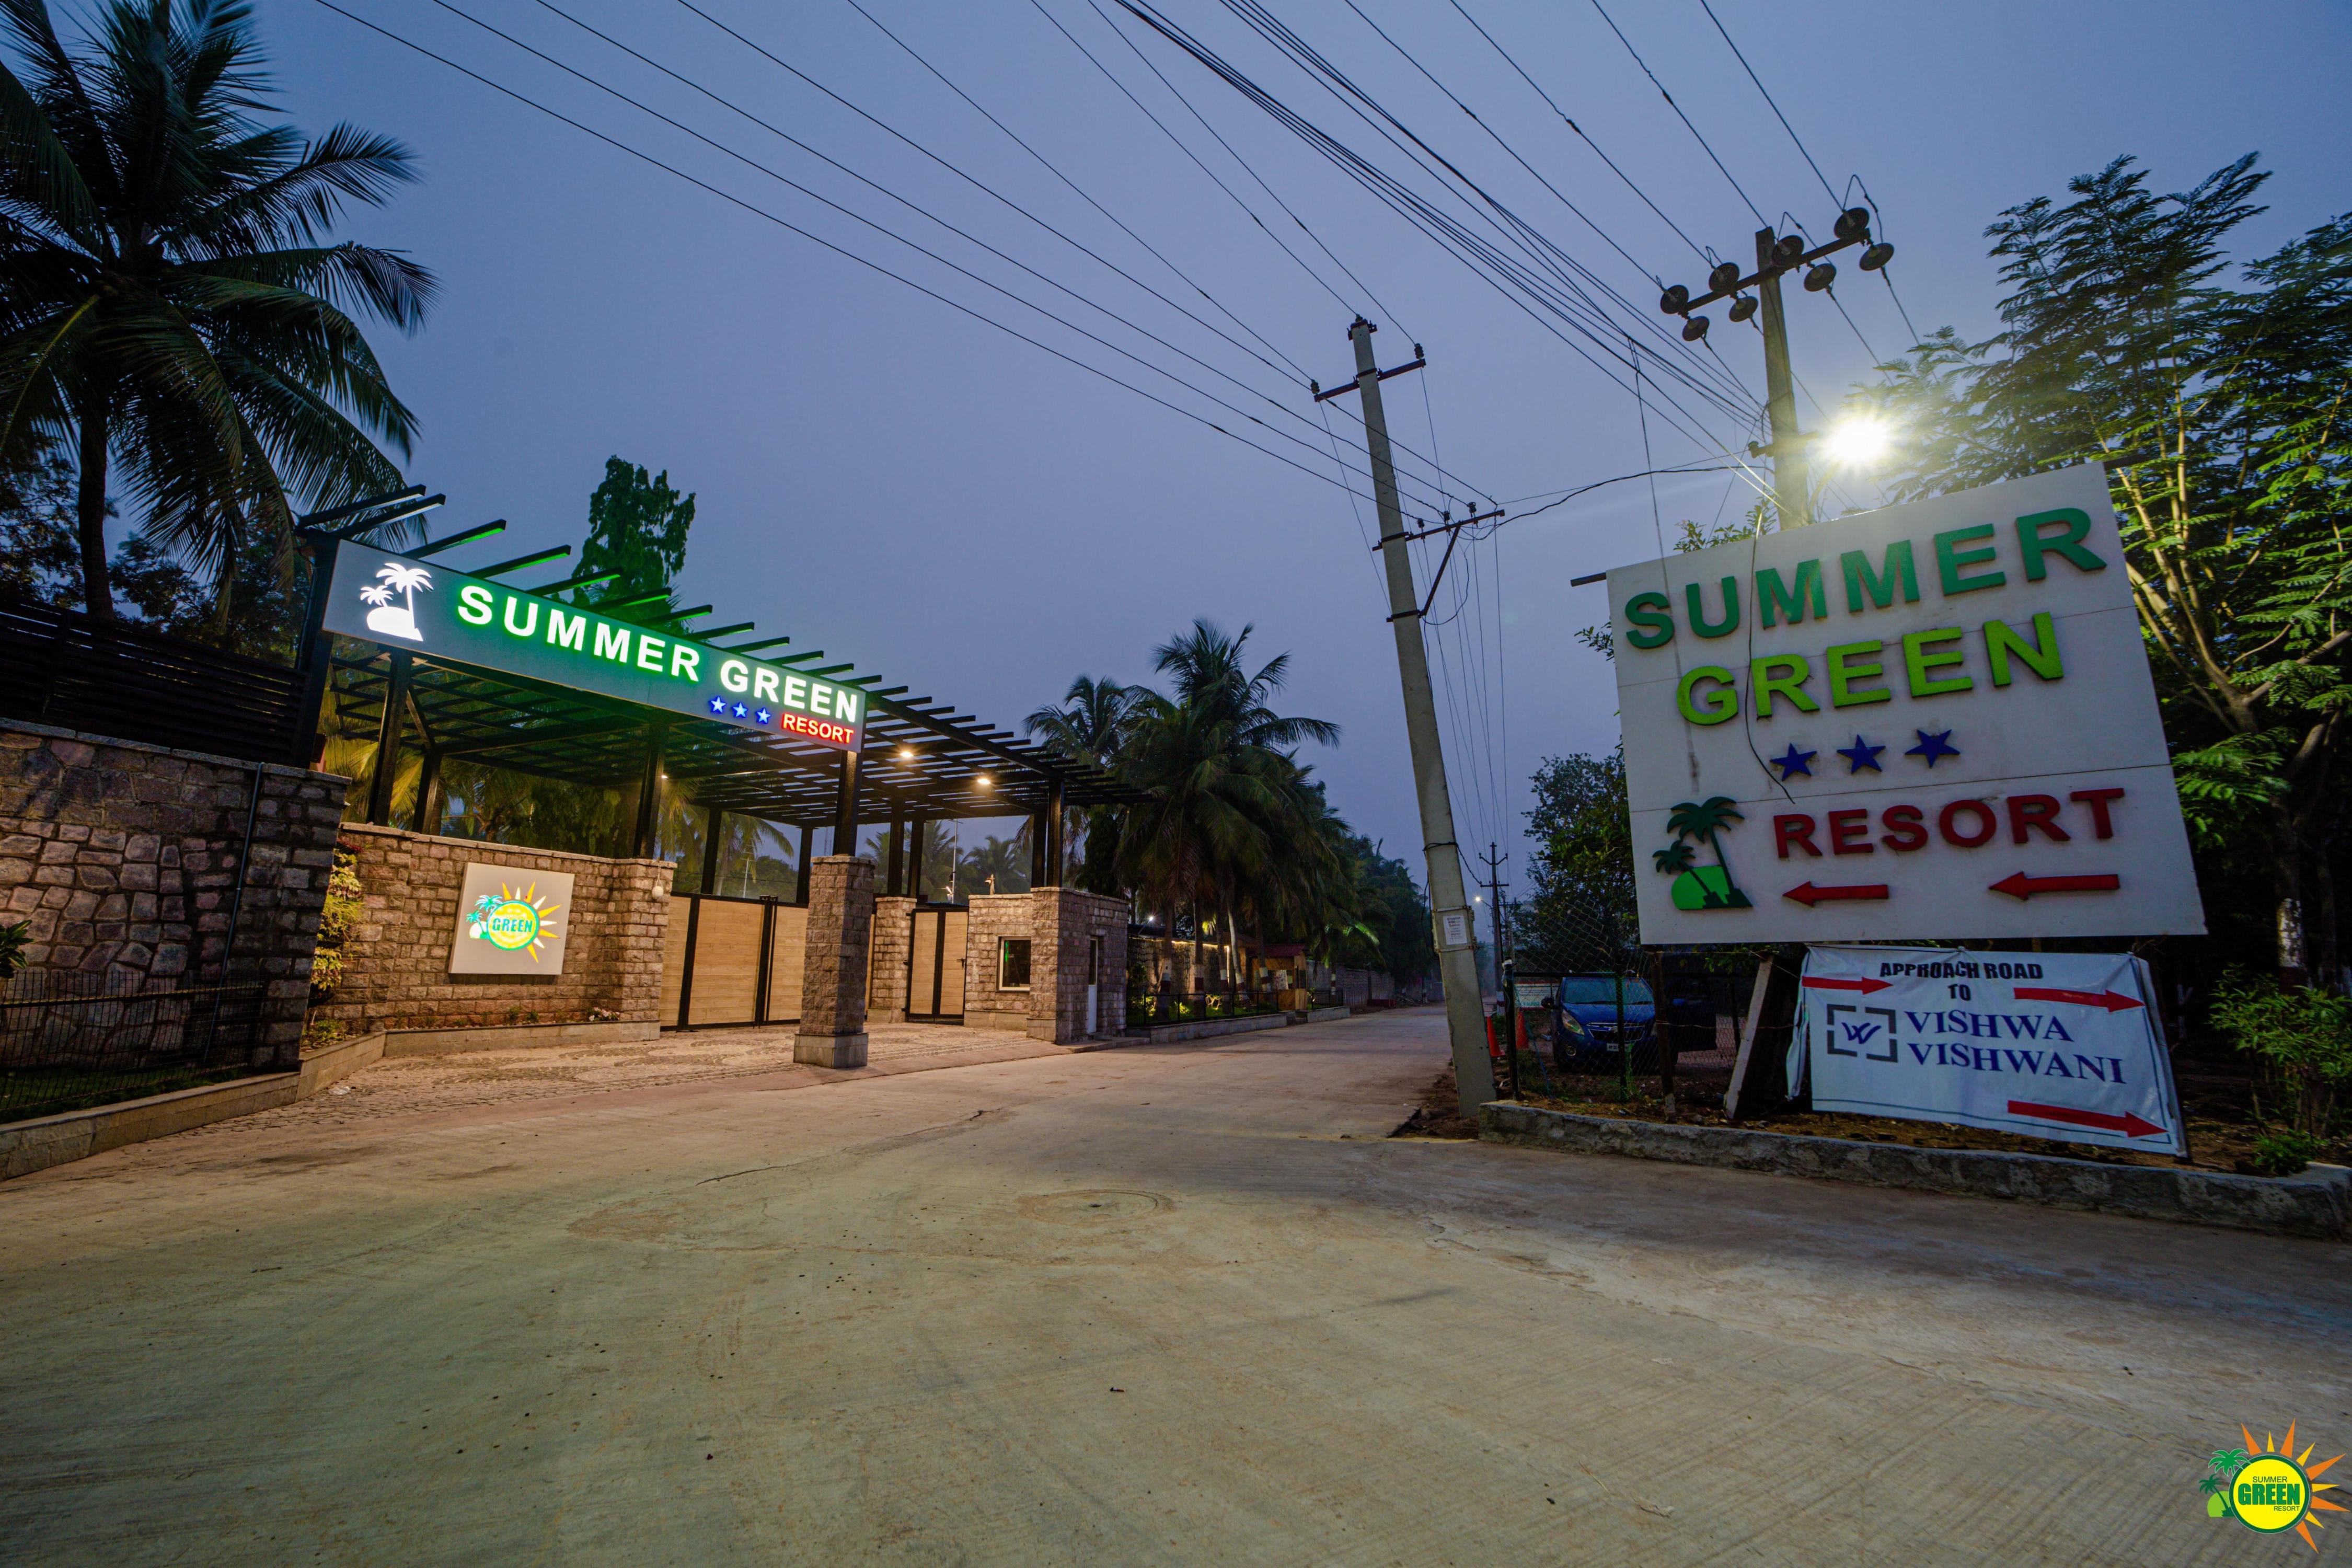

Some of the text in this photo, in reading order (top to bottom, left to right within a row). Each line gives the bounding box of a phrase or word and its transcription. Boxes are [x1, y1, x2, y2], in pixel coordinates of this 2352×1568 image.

[1624, 507, 2107, 650] SUMMER
[458, 585, 699, 682] SUMMER
[1676, 612, 2064, 725] GREEN
[720, 659, 858, 722] GREEN
[783, 712, 854, 744] RESORT
[1773, 788, 2125, 859] RESORT
[492, 918, 533, 932] GREEN
[1880, 961, 2043, 979] APPROACH ROAD
[1948, 983, 1971, 1001] TO
[1904, 1009, 2074, 1042] VISHWA
[1907, 1043, 2128, 1084] VISHWANI
